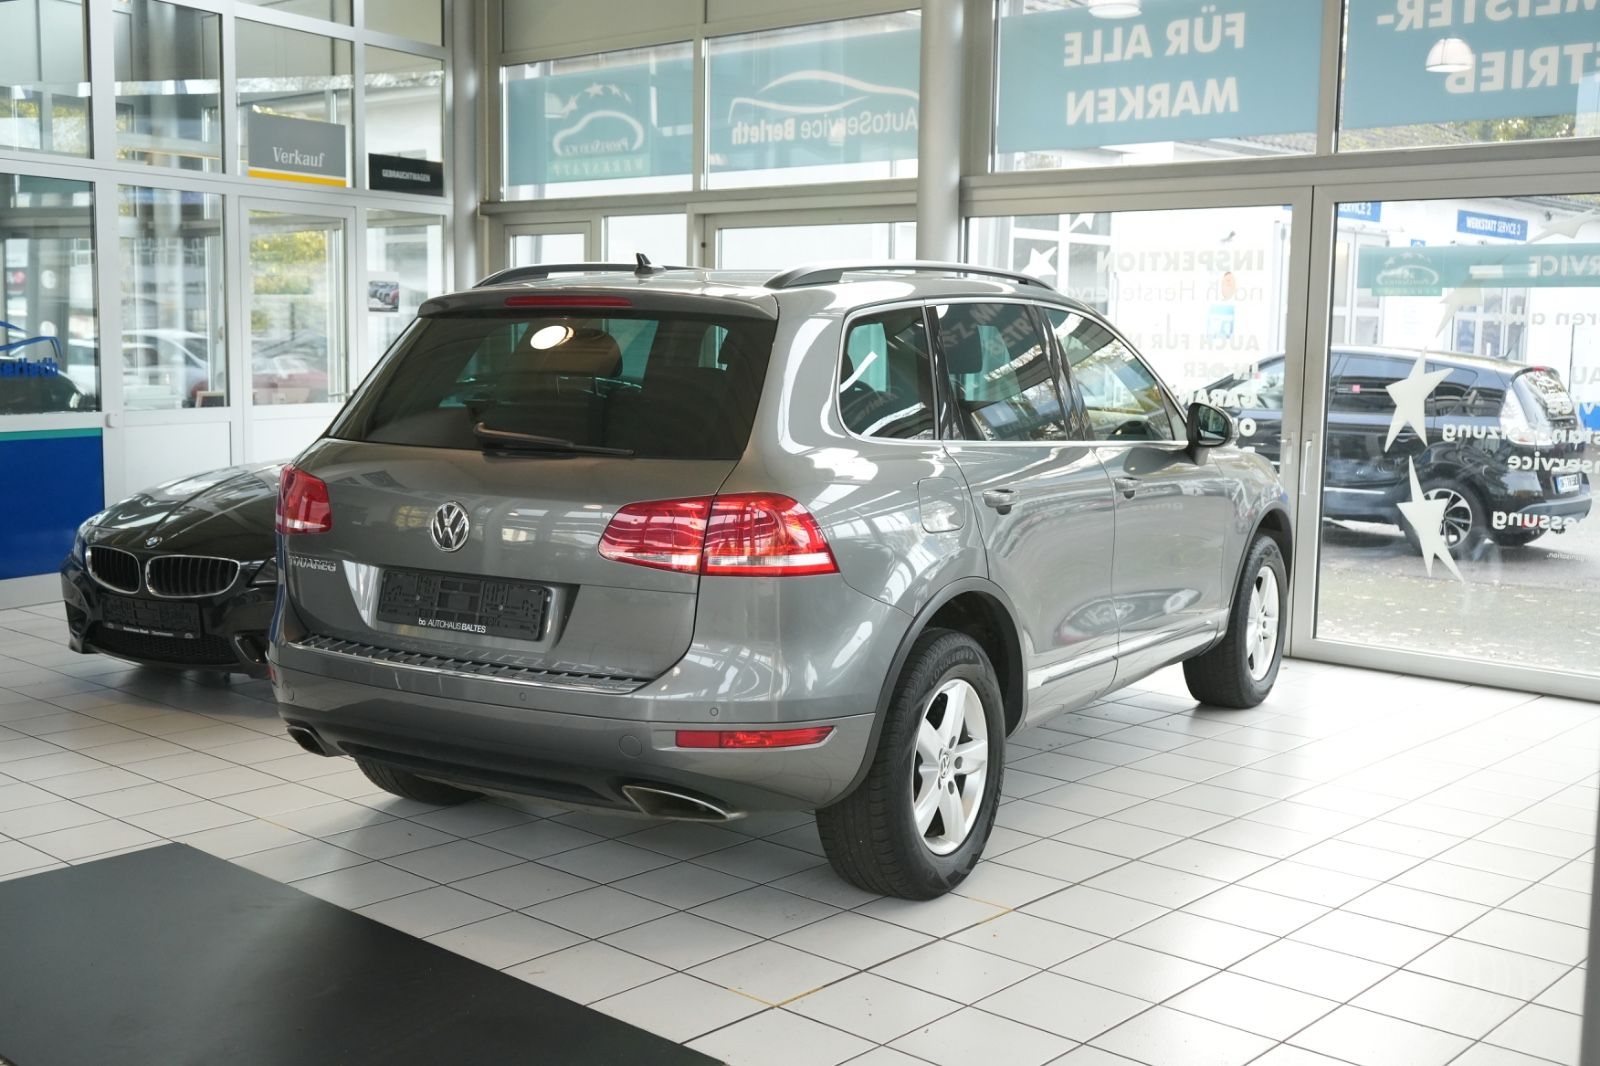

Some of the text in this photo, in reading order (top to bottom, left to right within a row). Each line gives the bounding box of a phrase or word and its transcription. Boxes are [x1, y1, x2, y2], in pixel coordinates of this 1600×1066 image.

[272, 146, 325, 168] Verkauf
[381, 168, 431, 182] GEBRAUCHTWAGEN
[427, 619, 462, 630] AUTOHAUS
[461, 622, 486, 634] BALTES
